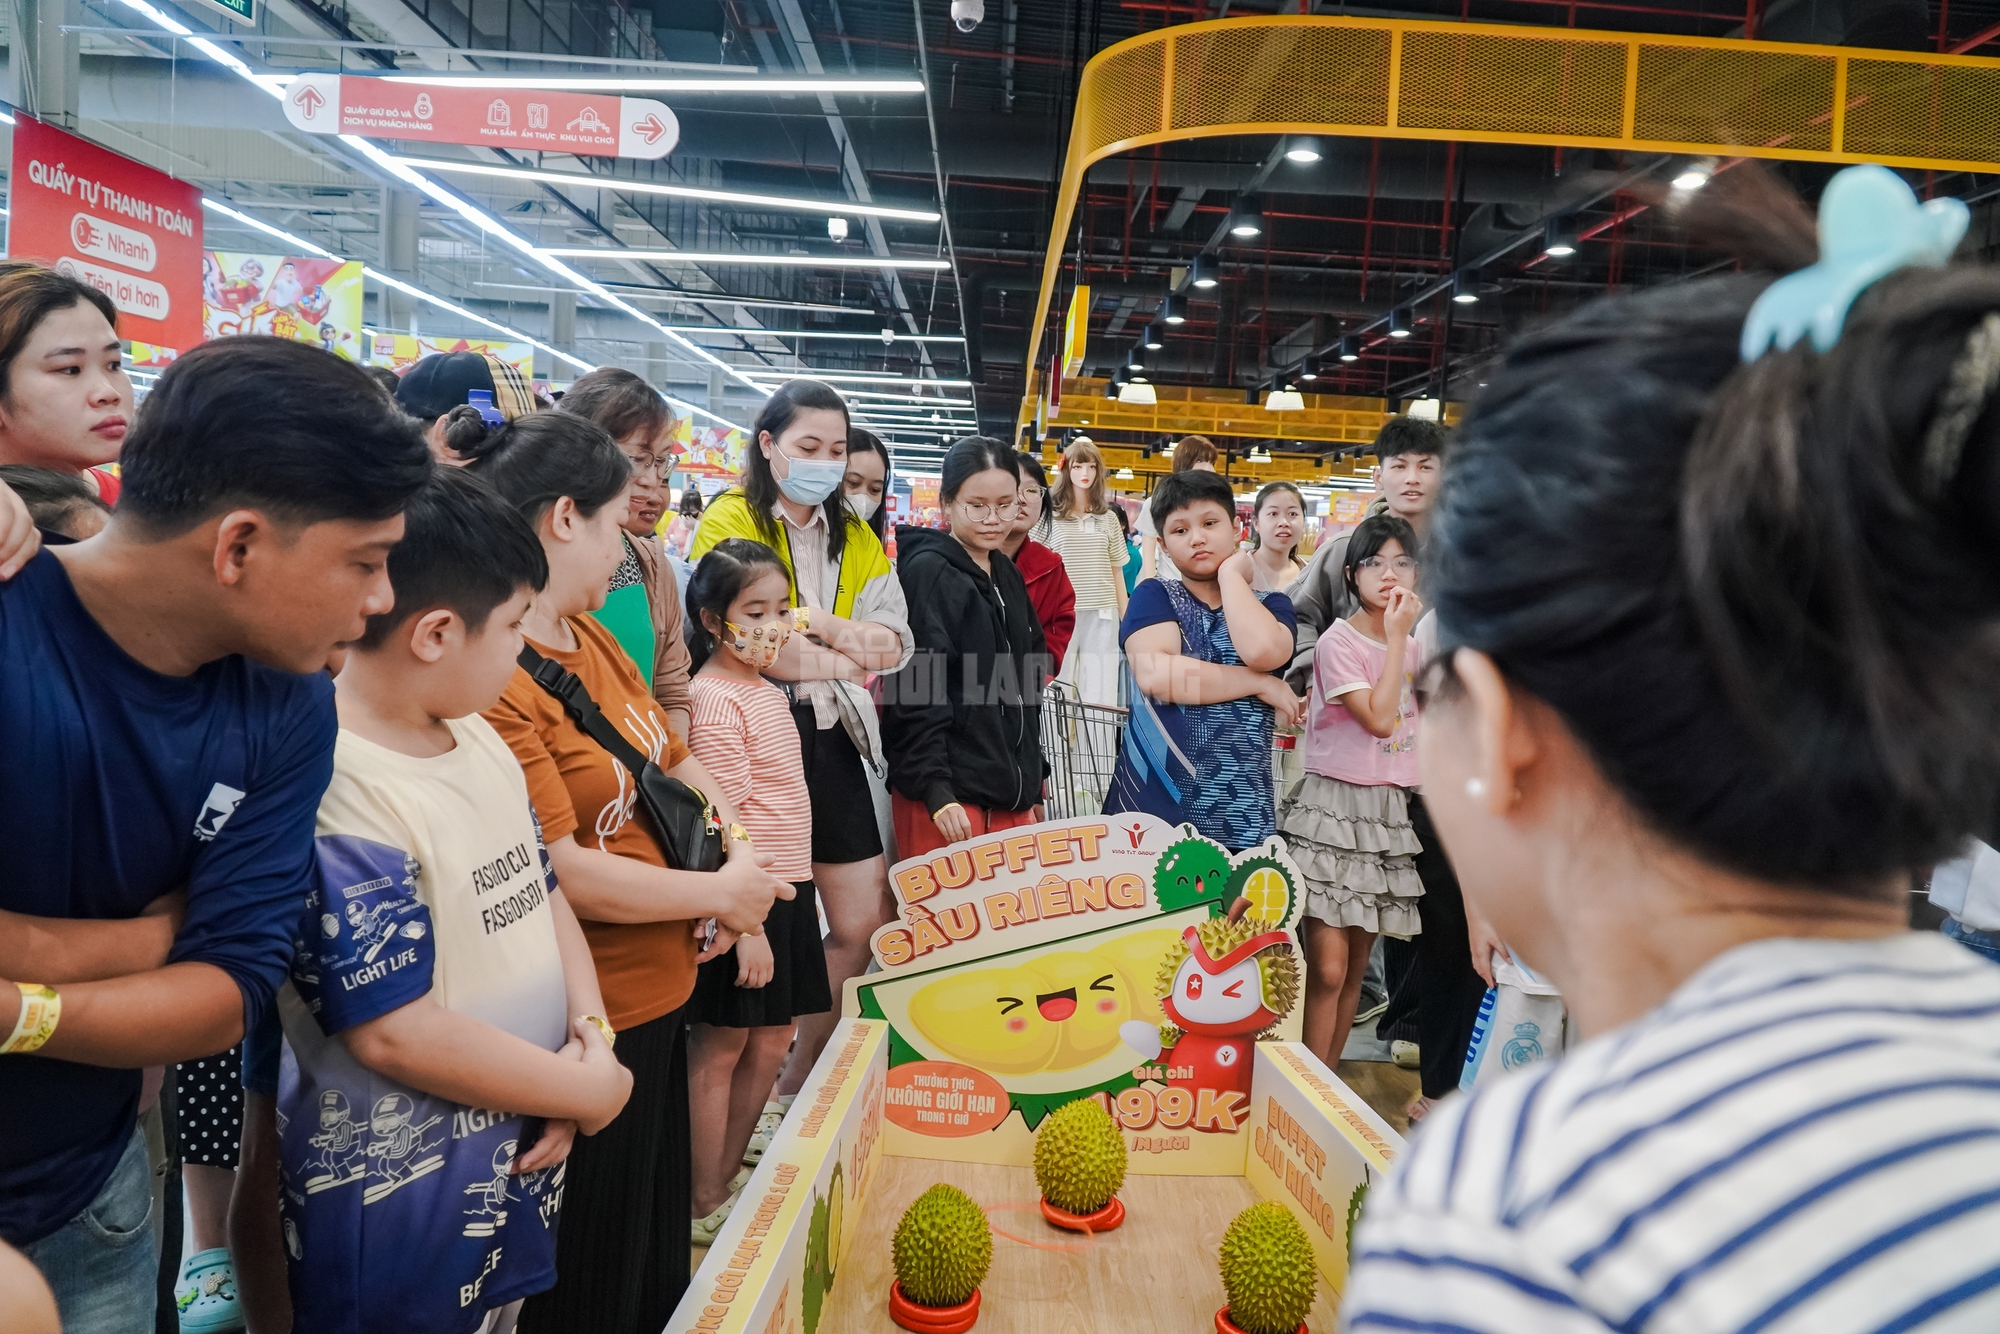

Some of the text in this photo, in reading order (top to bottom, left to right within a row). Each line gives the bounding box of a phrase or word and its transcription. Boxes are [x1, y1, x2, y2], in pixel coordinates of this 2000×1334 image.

[480, 128, 498, 136] MUA
[560, 133, 615, 145] KHU VUI CHƠI
[28, 159, 194, 238] QUẦY TỰ THANH TOÁN
[107, 231, 149, 262] Nhanh
[116, 279, 132, 306] lợi
[135, 290, 160, 310] hơn
[894, 824, 1109, 906] BUFFET
[876, 873, 1147, 966] SẦU RIÊNG
[341, 947, 417, 991] LIGHT LIFE
[851, 1023, 871, 1037] GIỜ
[835, 1041, 863, 1068] TRONG
[826, 1066, 850, 1086] HẠN
[913, 1072, 975, 1091] THƯỞNG THỨC
[1132, 1064, 1194, 1080] Giá chỉ
[816, 1084, 840, 1104] GIỚI
[886, 1084, 933, 1108] KHÔNG
[936, 1089, 964, 1111] GIỚI
[967, 1094, 996, 1117] HẠN
[797, 1104, 831, 1138] KHÔNG
[916, 1110, 970, 1126] TRONG 1 GIỜ
[1339, 1109, 1383, 1141] TRONG
[1131, 1135, 1190, 1154] /Người
[1267, 1095, 1327, 1181] BUFFET
[773, 1163, 800, 1185] GIỜ
[1254, 1123, 1335, 1242] SẦU RIÊNG
[769, 1186, 790, 1194] 1
[744, 1194, 786, 1238] TRONG
[727, 1239, 762, 1270] HẠN
[710, 1270, 747, 1303] GIỚI
